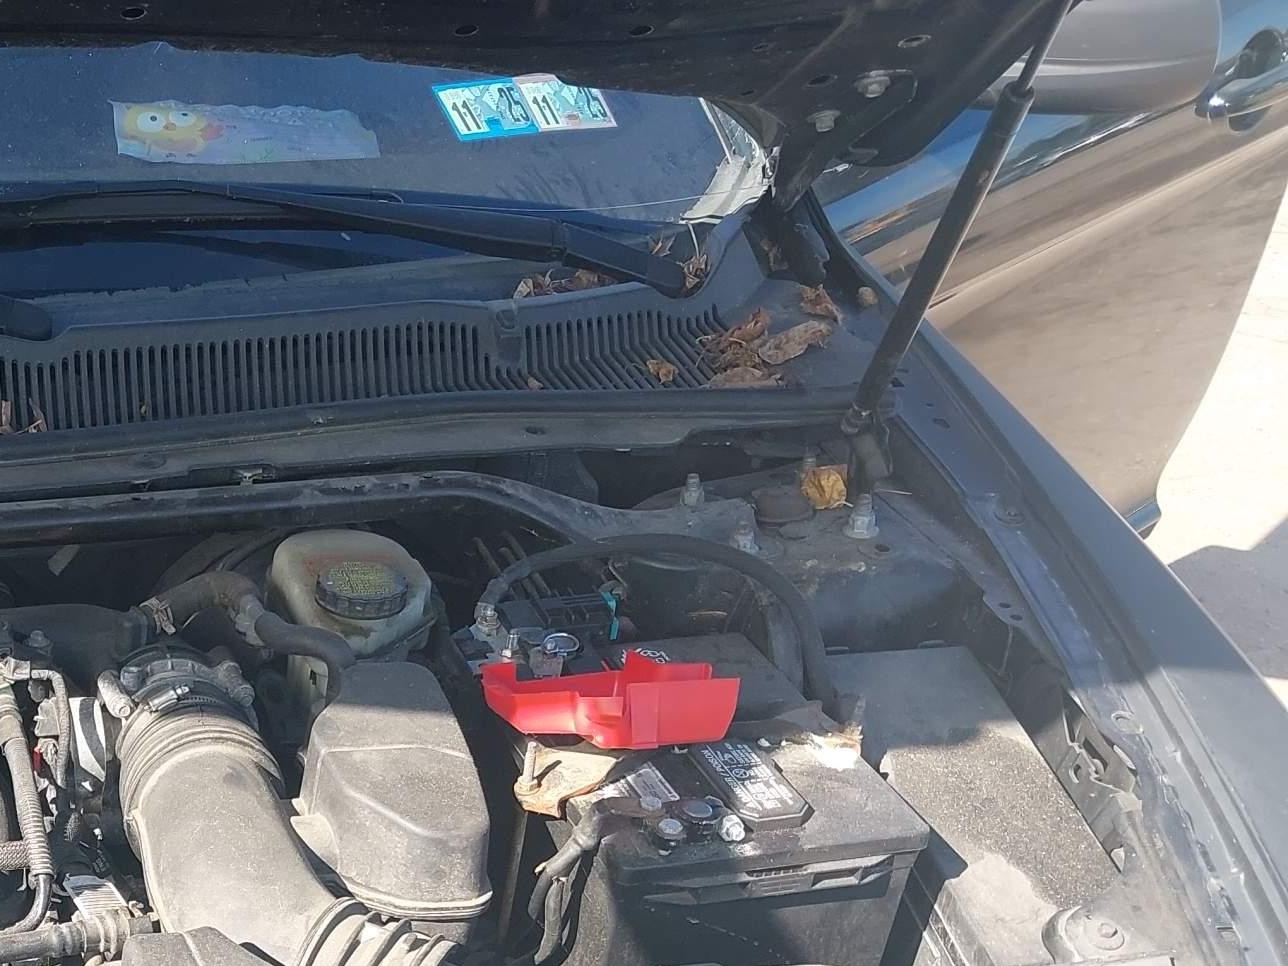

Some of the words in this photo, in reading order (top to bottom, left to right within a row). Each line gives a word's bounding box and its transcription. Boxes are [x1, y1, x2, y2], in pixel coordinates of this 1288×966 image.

[451, 99, 482, 132] 11
[496, 85, 530, 123] 25
[531, 94, 561, 126] 11
[575, 86, 609, 118] 25
